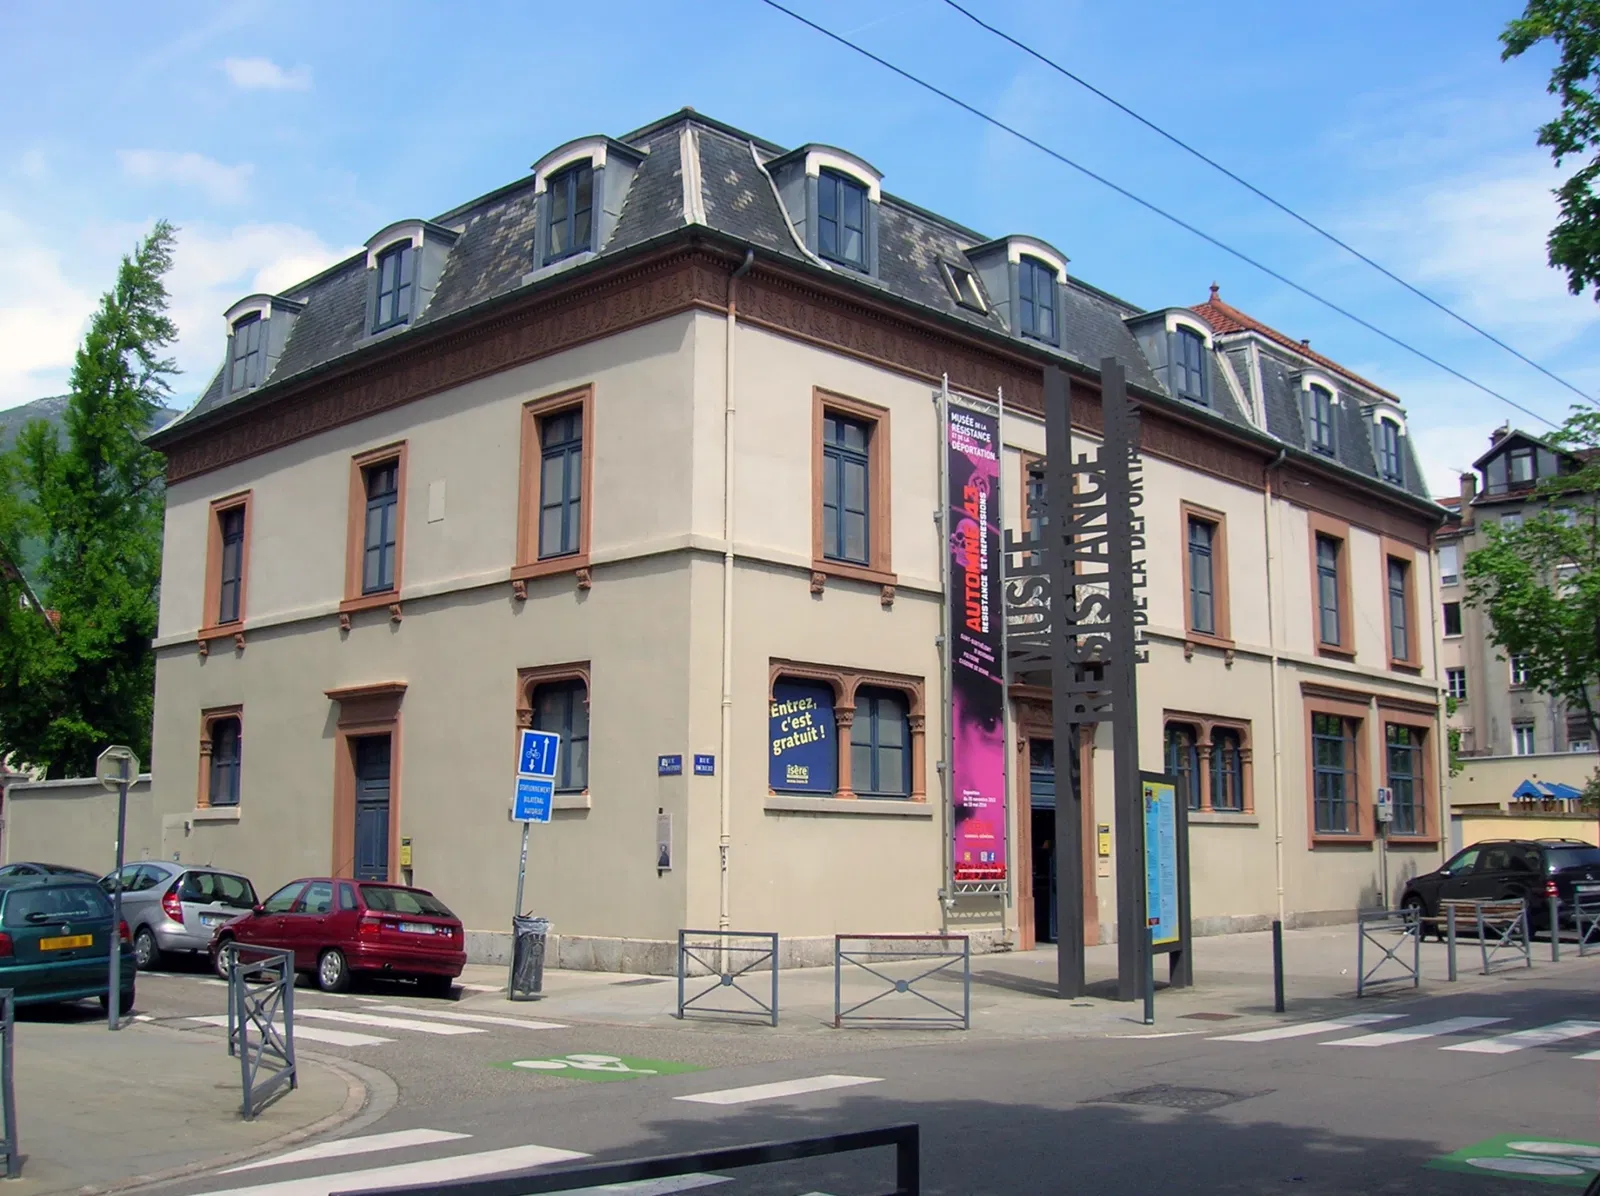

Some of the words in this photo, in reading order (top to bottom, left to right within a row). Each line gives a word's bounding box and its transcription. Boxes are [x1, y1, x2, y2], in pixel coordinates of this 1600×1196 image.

[951, 412, 974, 427] MUSÉE
[951, 422, 991, 441] RÉSISTANCE
[951, 440, 996, 460] DÉPORTATION
[963, 485, 979, 521] 43
[980, 556, 988, 570] ET
[964, 524, 981, 633] AUTOMNE
[771, 697, 817, 717] Entrez,
[781, 711, 812, 732] c'est
[773, 727, 819, 756] gratuit
[820, 724, 825, 739] !
[786, 764, 808, 775] isère
